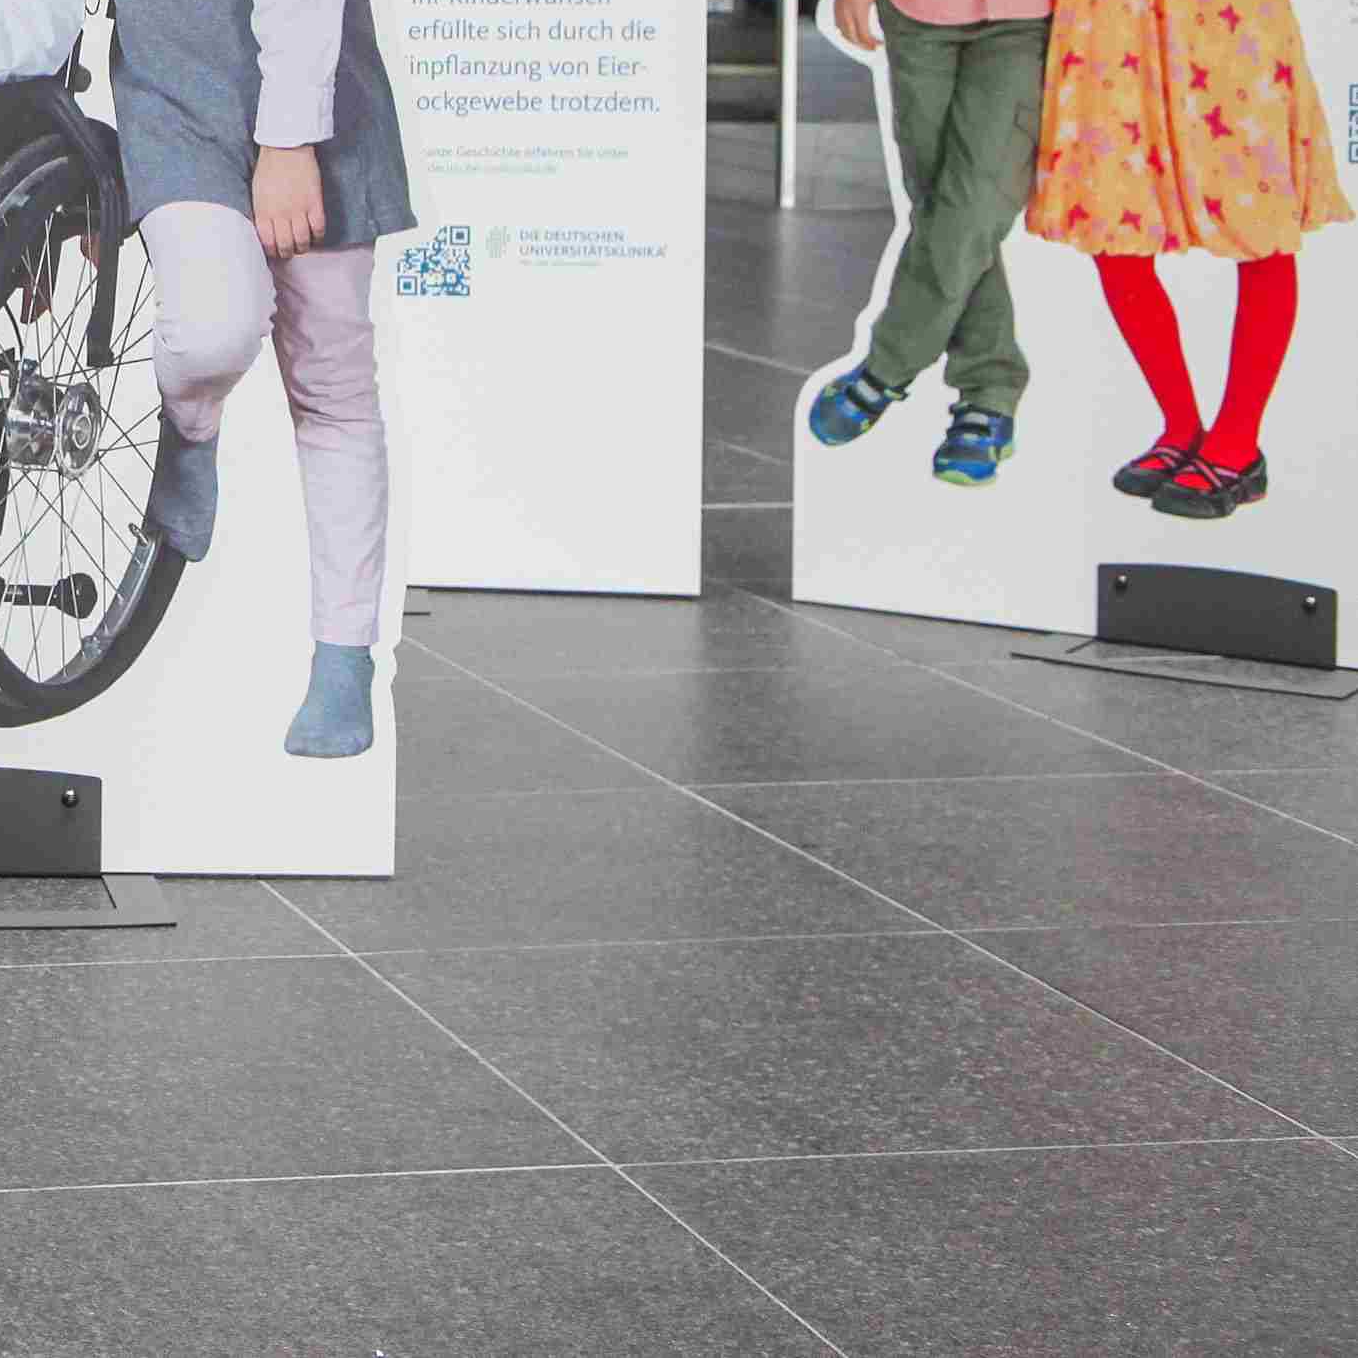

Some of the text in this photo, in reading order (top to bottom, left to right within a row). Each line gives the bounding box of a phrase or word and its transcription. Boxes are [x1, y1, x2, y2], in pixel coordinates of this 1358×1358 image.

[407, 18, 656, 41] erfüllte sich durch die
[405, 52, 649, 80] inpflanzung von Eier-
[414, 89, 661, 117] ockgewebe trotzdem.
[519, 230, 625, 243] DIE DEUTSCHEN
